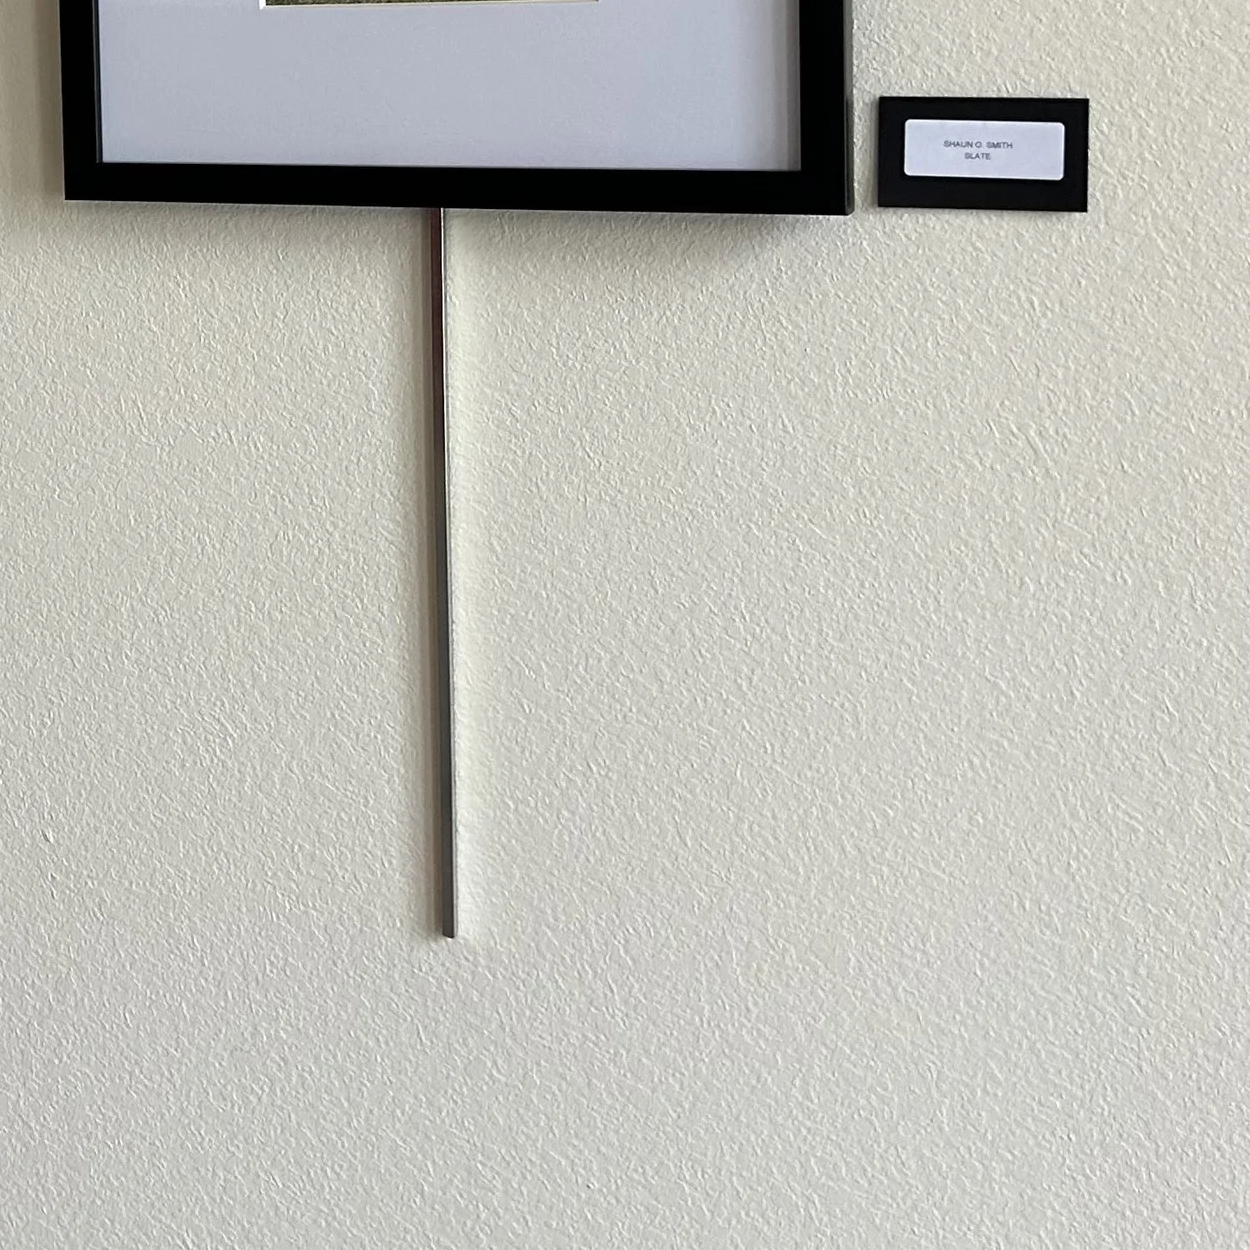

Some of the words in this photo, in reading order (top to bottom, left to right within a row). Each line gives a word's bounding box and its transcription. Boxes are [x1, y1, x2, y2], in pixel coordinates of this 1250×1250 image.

[943, 140, 973, 148] SHAUN
[985, 141, 1013, 149] SMITH
[964, 152, 991, 160] SLATE
